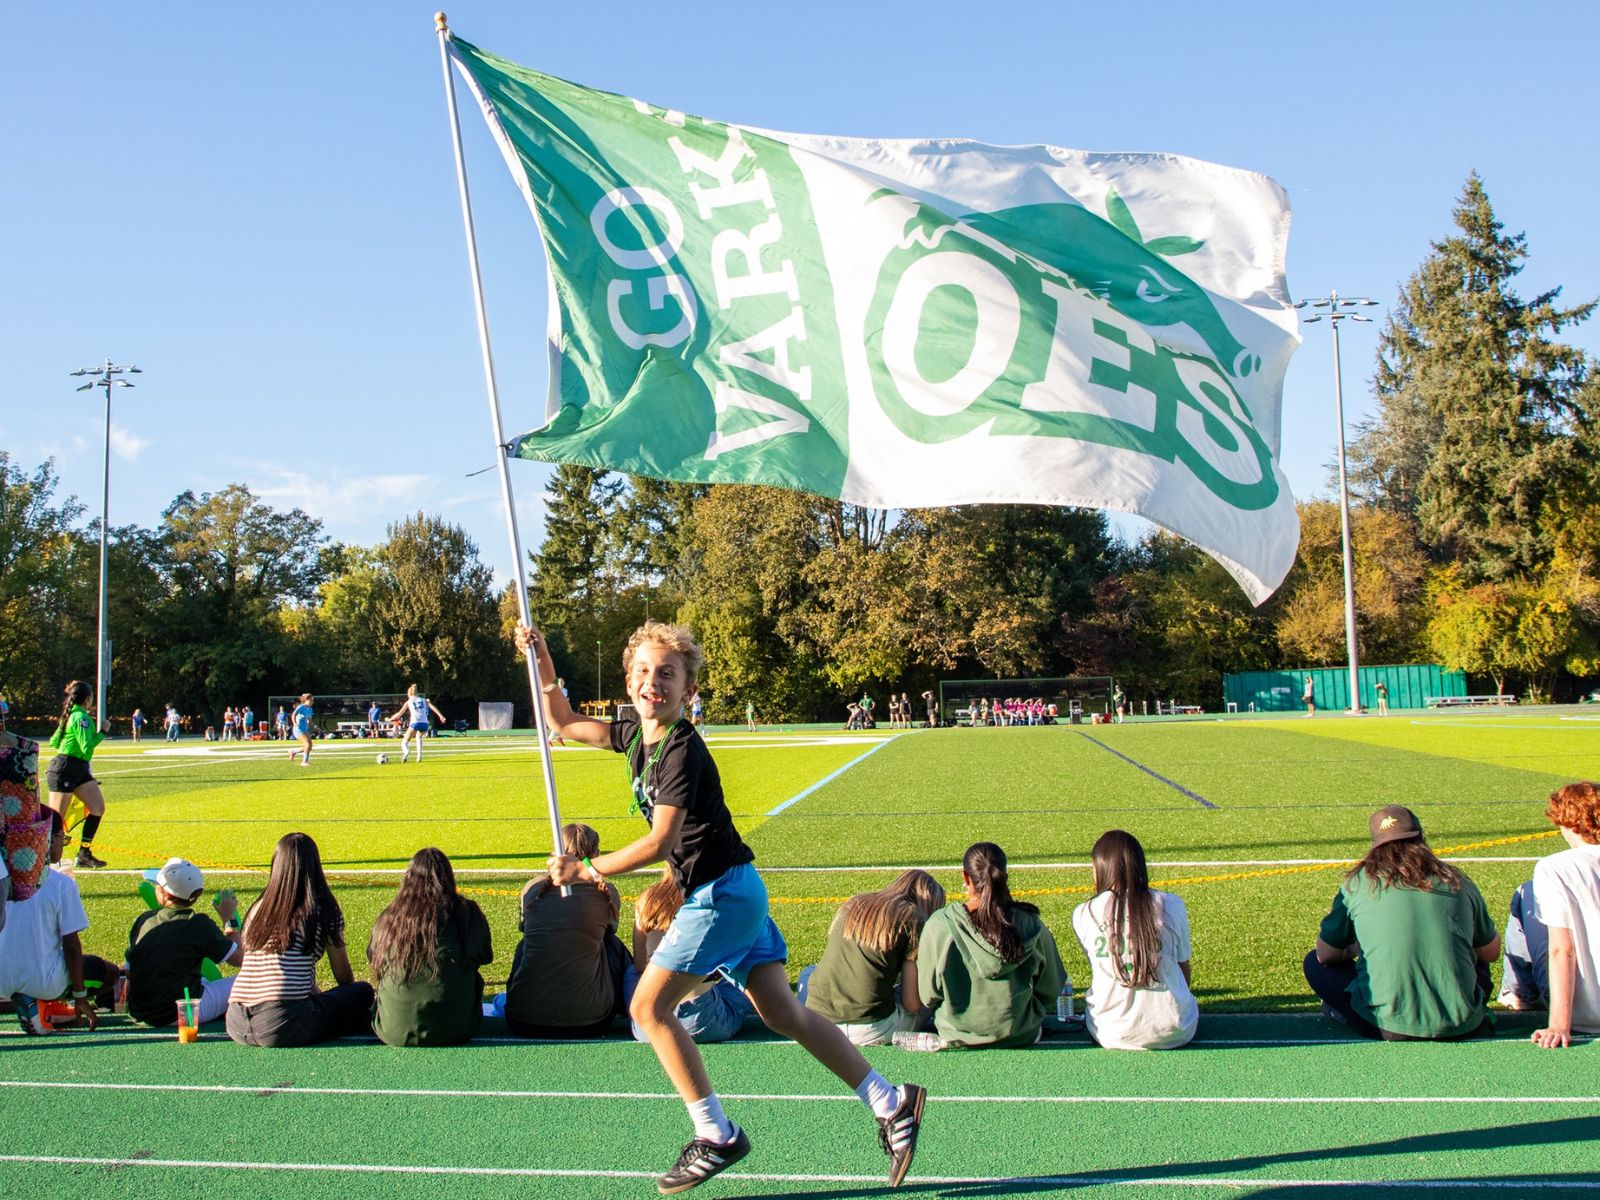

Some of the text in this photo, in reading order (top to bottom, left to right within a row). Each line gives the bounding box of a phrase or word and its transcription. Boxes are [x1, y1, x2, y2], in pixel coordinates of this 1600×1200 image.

[589, 186, 698, 350] GO
[632, 98, 812, 460] VARK
[882, 252, 1263, 485] OES
